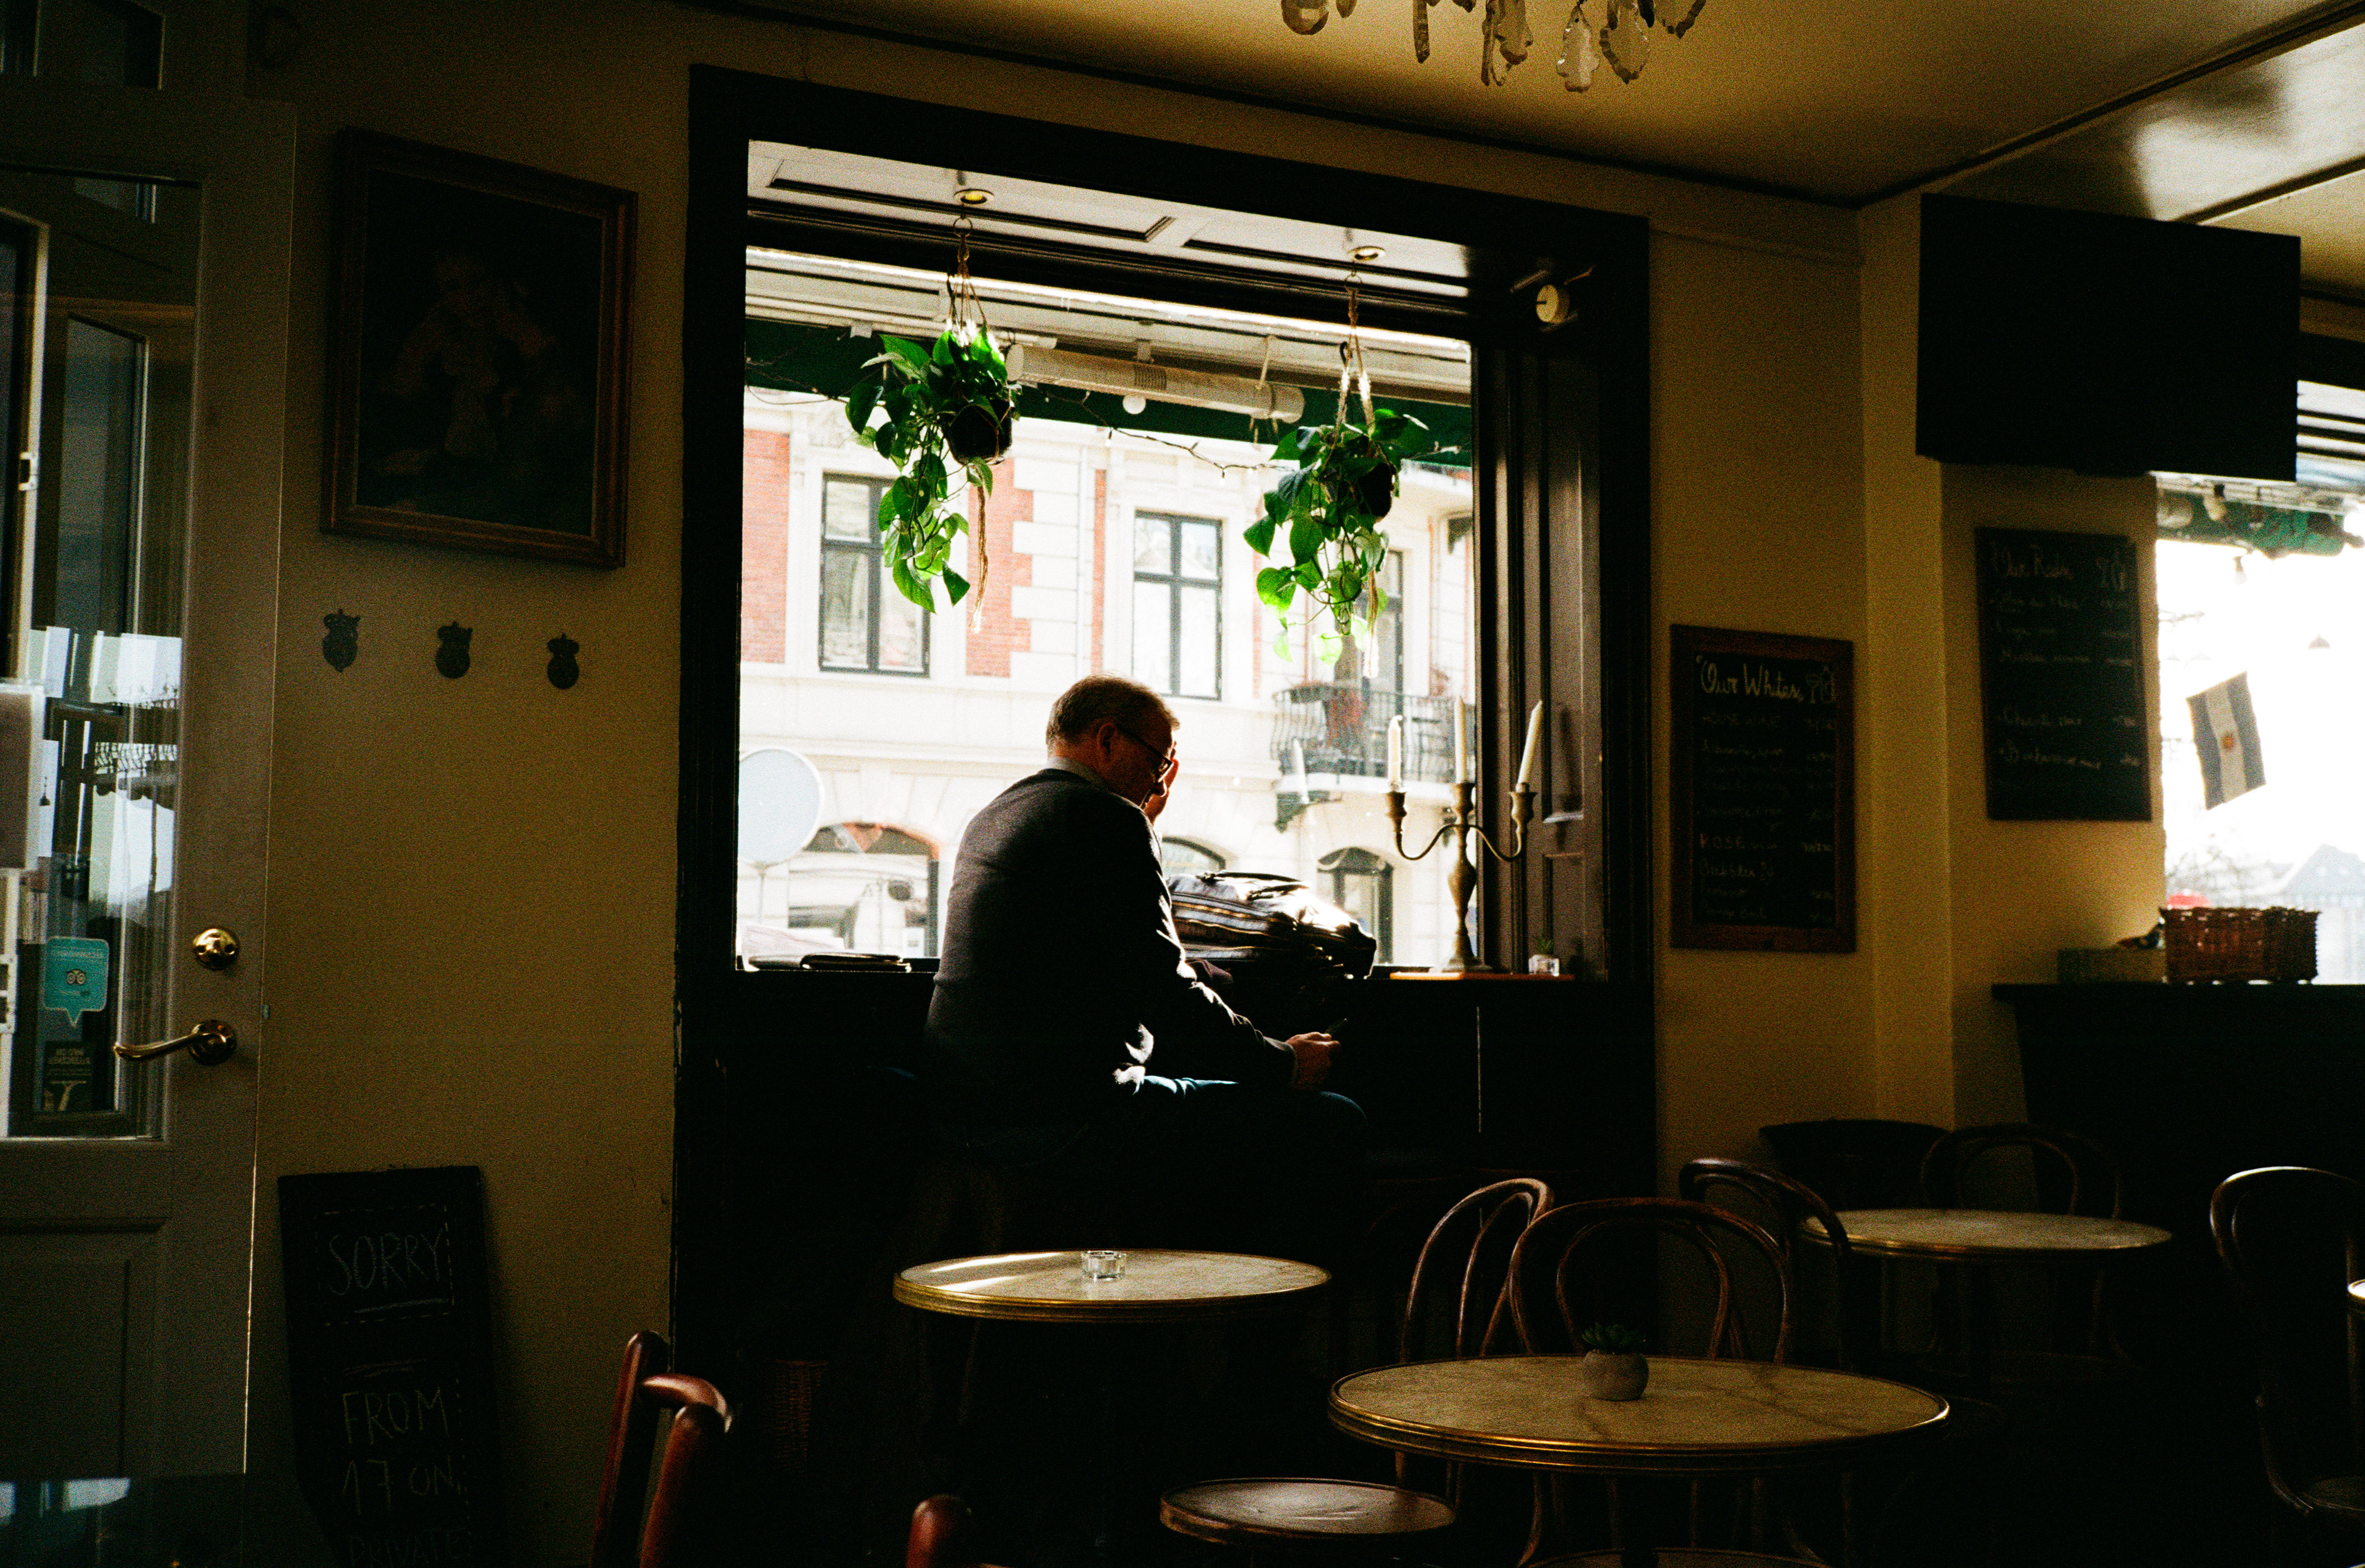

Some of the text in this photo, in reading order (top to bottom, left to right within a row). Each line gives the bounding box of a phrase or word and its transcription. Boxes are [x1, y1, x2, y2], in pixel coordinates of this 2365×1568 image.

[327, 1228, 444, 1297] SORRY
[342, 1385, 450, 1446] FROM
[341, 1459, 392, 1516] 17
[346, 1525, 468, 1568] PRIVATE
